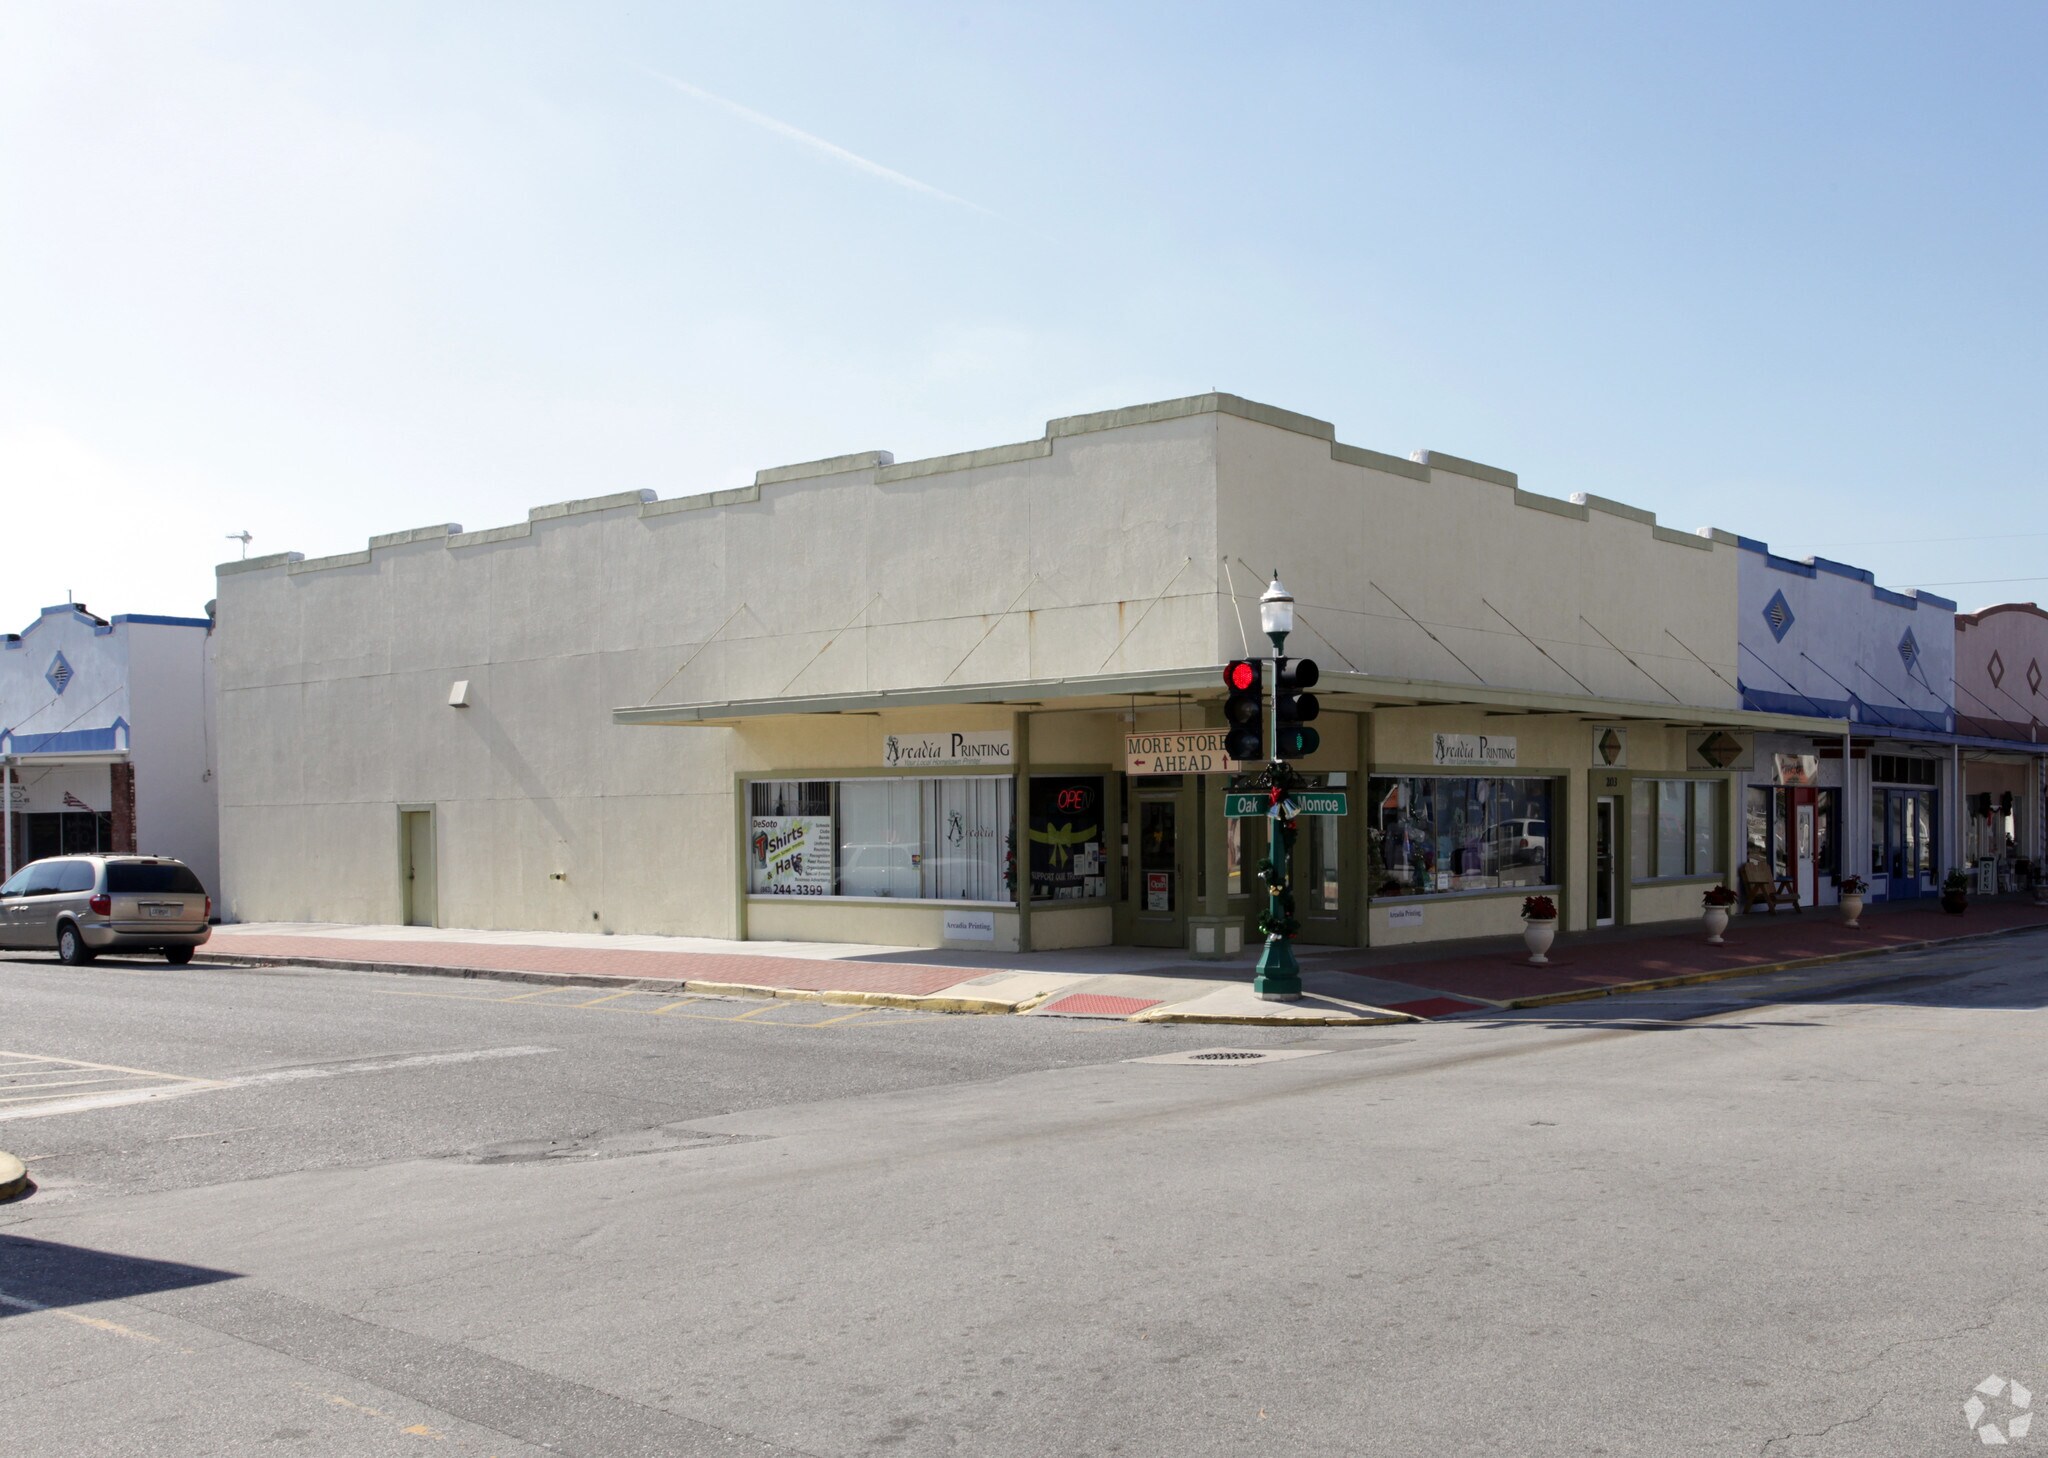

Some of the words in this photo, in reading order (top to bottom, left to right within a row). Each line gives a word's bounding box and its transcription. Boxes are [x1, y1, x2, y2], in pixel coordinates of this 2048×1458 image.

[886, 735, 942, 765] Arcadia
[951, 733, 1010, 758] PRINTING
[1128, 737, 1172, 754] MORE
[1177, 735, 1230, 752] STORE
[1435, 735, 1474, 764] Arcadia
[1479, 736, 1516, 760] PRINTING
[1153, 755, 1212, 772] AHEAD
[1058, 789, 1092, 809] OPEN
[1237, 796, 1258, 813] Oak
[1297, 795, 1339, 812] Monroe
[753, 819, 778, 828] DeSoto
[768, 826, 804, 853] Shirts
[775, 853, 803, 875] Hats
[773, 884, 823, 896] 244-3399
